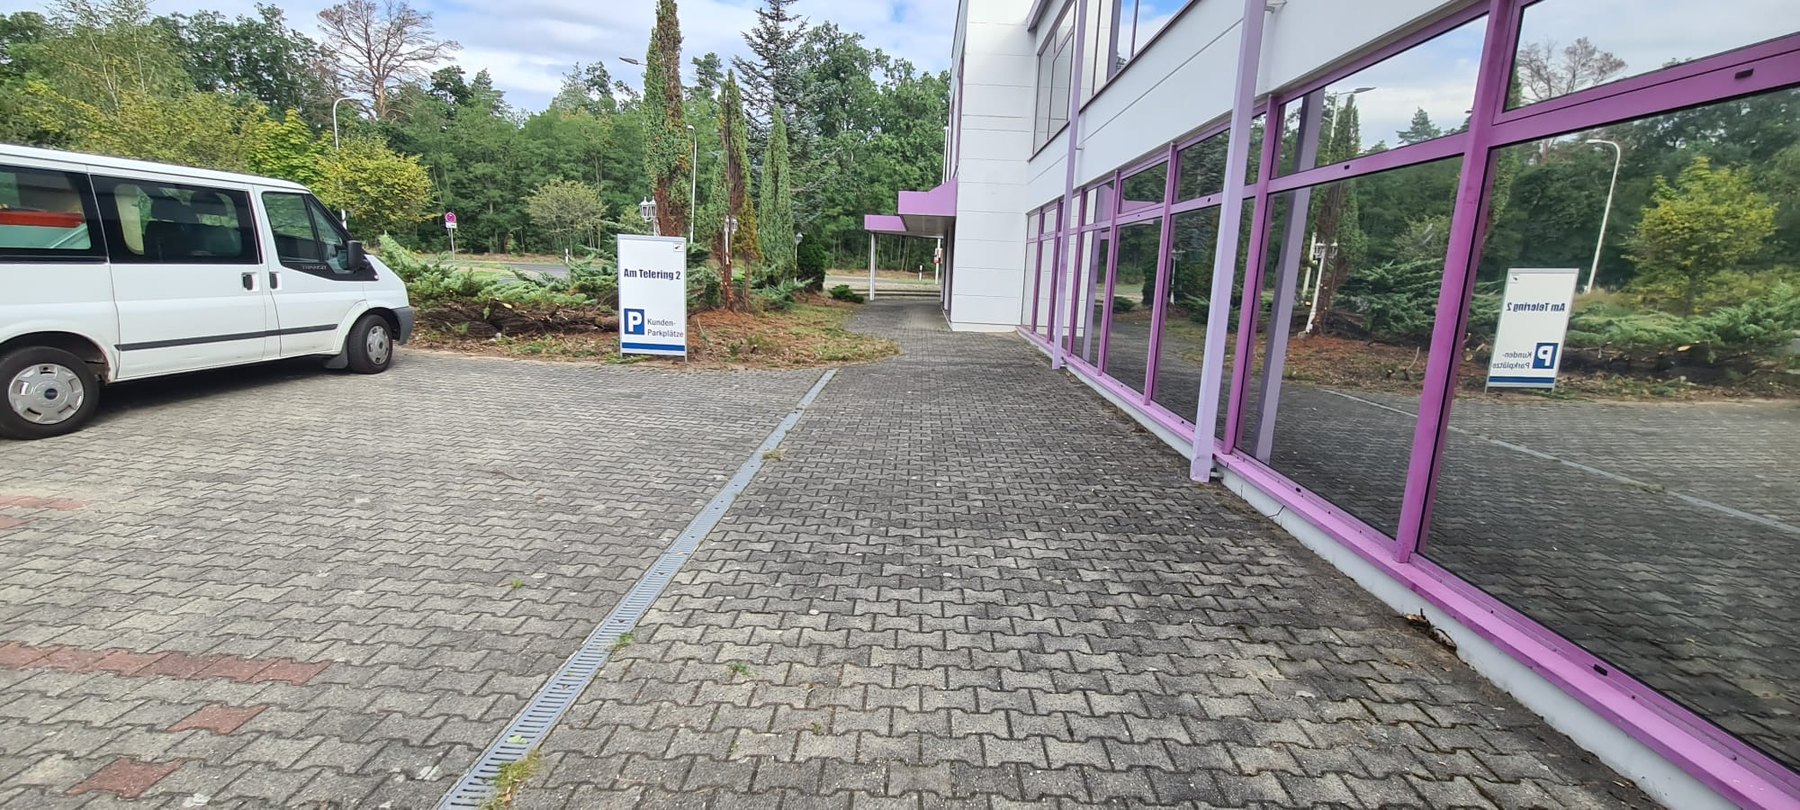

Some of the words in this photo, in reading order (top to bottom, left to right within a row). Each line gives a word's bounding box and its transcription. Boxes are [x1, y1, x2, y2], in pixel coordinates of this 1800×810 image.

[623, 268, 637, 278] Am
[639, 269, 674, 280] Telering
[675, 270, 681, 280] 2
[627, 311, 643, 332] P
[647, 318, 677, 327] Kunden-
[647, 328, 684, 338] Parkplätze
